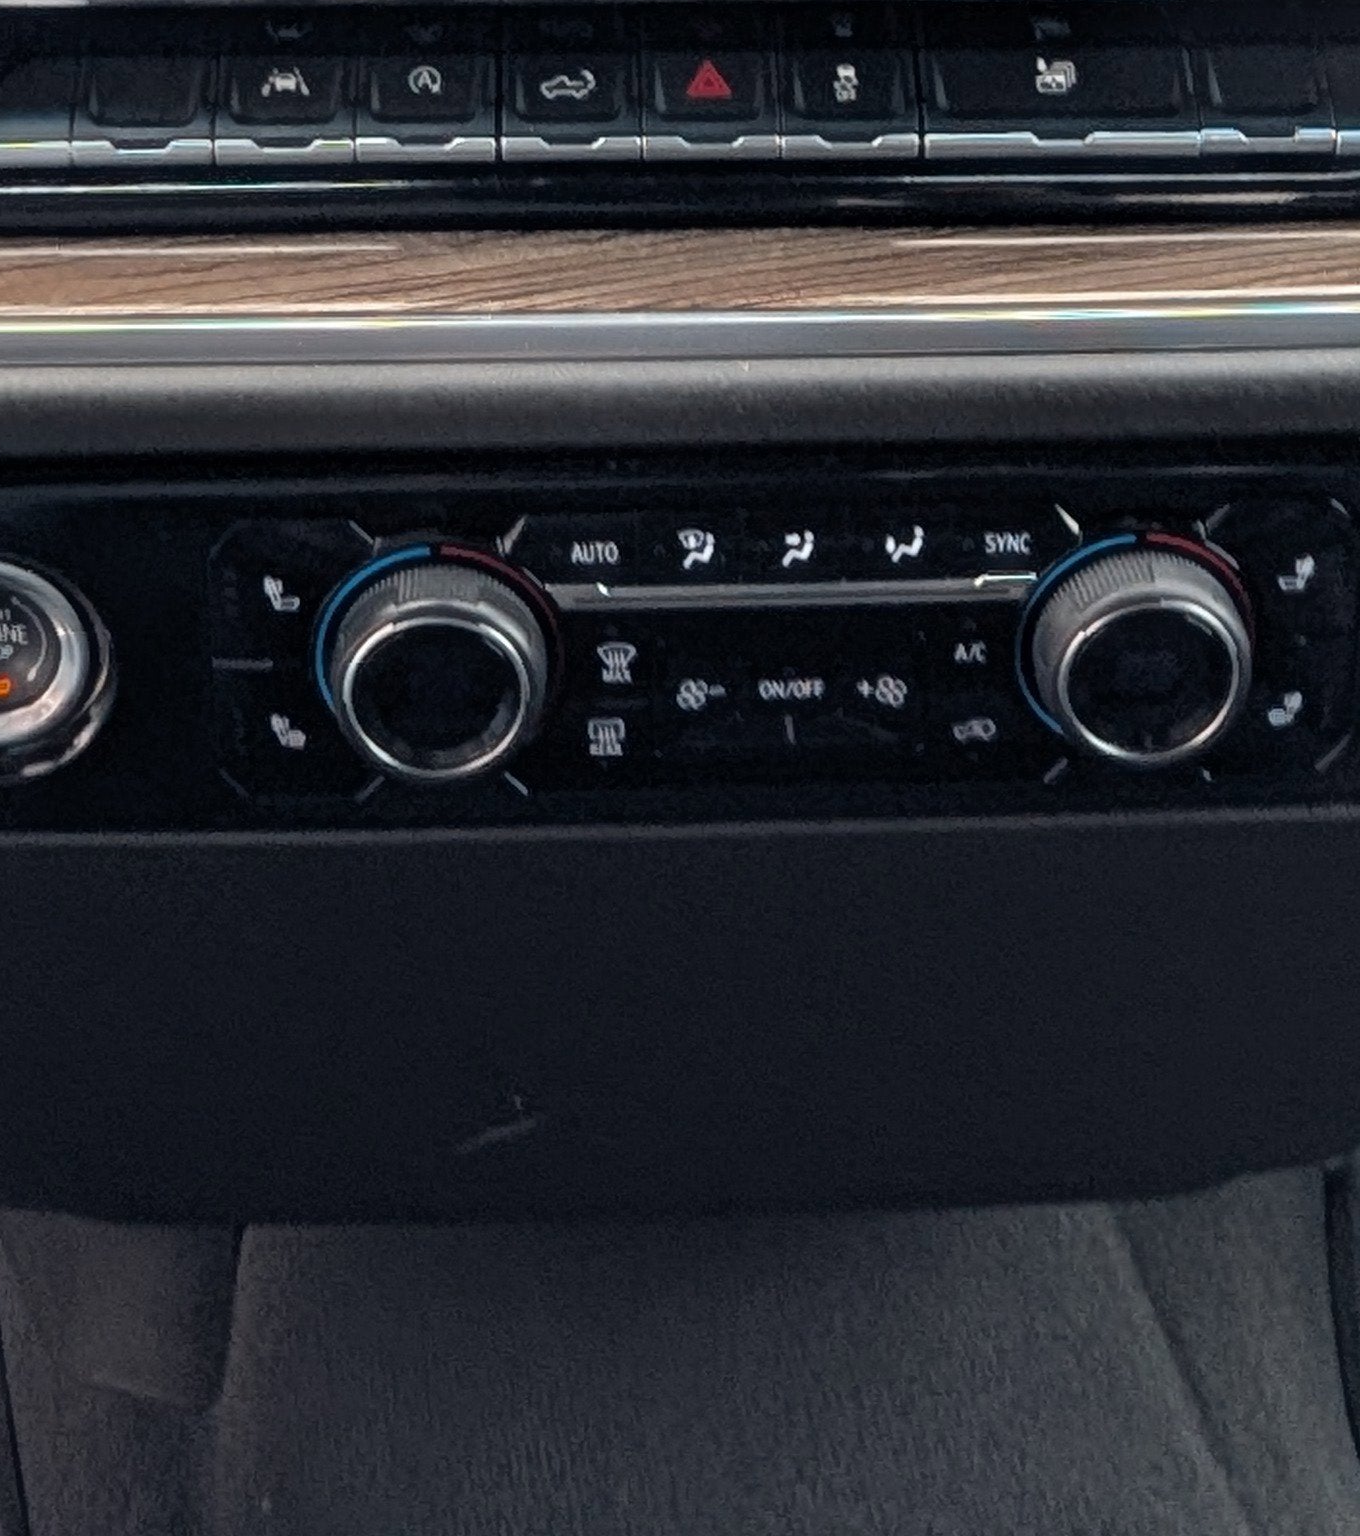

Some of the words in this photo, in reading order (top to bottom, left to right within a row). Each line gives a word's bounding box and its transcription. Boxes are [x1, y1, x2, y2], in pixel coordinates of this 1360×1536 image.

[571, 541, 619, 564] AUTO
[984, 532, 1032, 554] SYNC
[954, 642, 988, 664] A/C
[758, 678, 824, 700] ON/OFF
